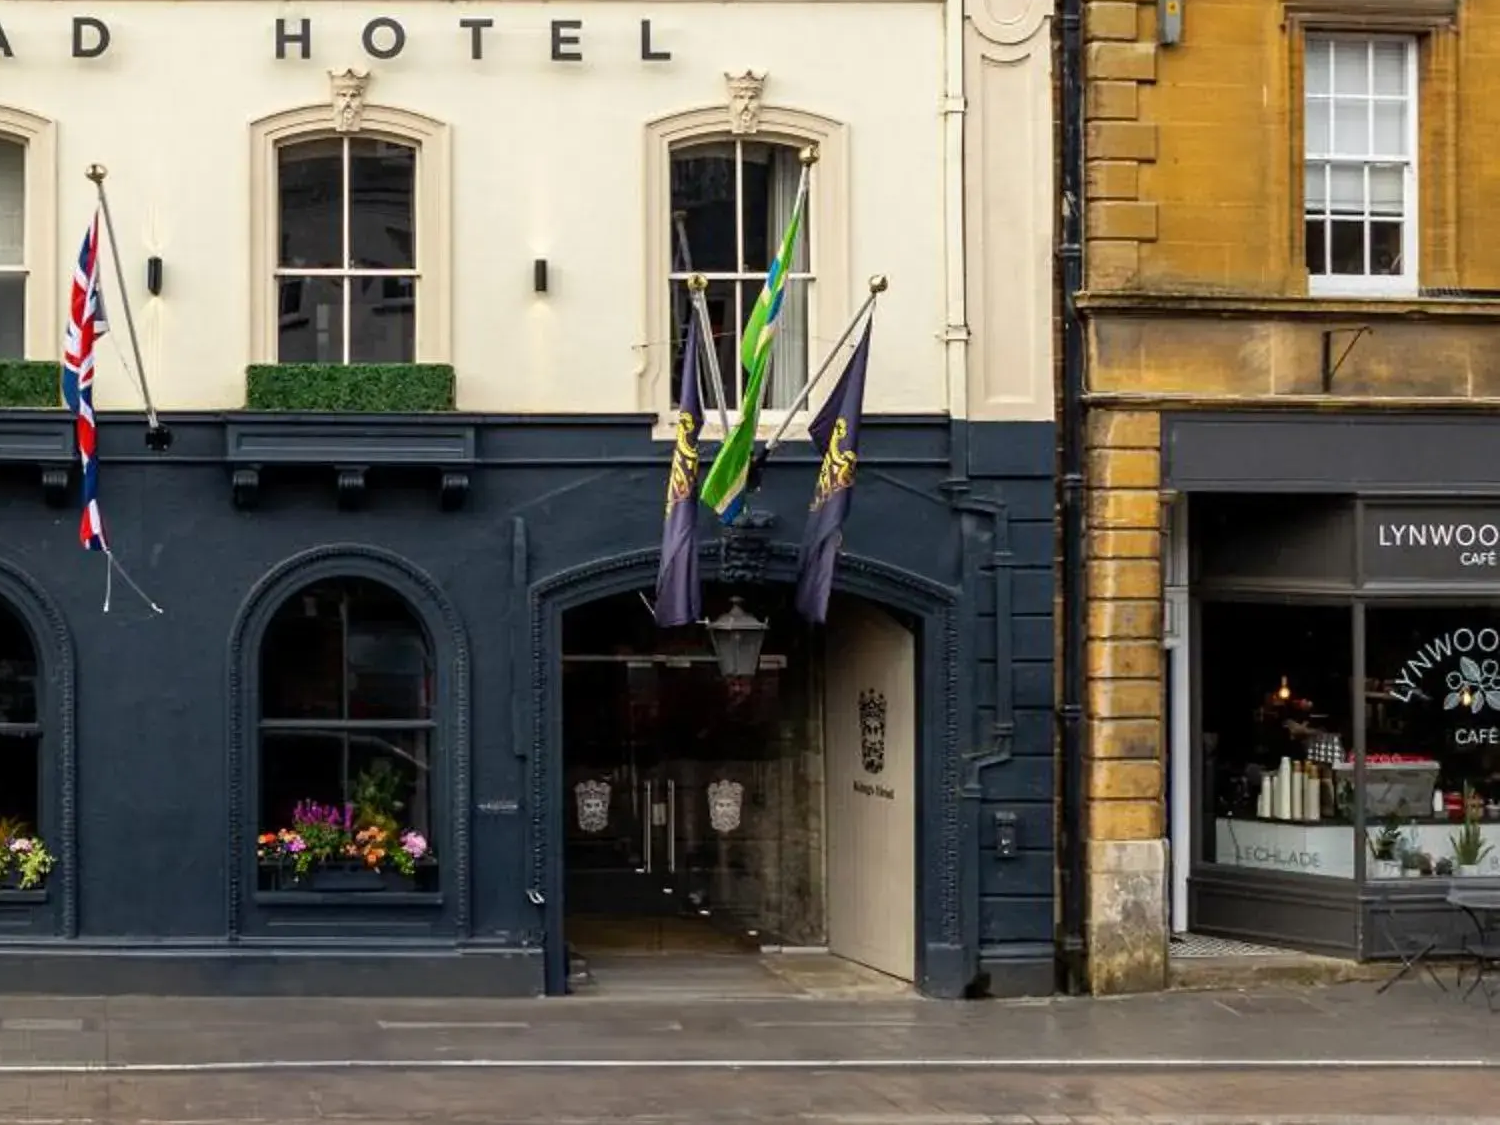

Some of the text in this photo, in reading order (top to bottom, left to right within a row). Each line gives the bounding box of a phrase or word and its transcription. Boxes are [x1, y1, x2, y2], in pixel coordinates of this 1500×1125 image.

[275, 17, 672, 62] HOTEL
[1379, 524, 1499, 546] LYNWOO
[1460, 550, 1497, 566] CAFÉ
[1455, 726, 1499, 744] CAFÉ
